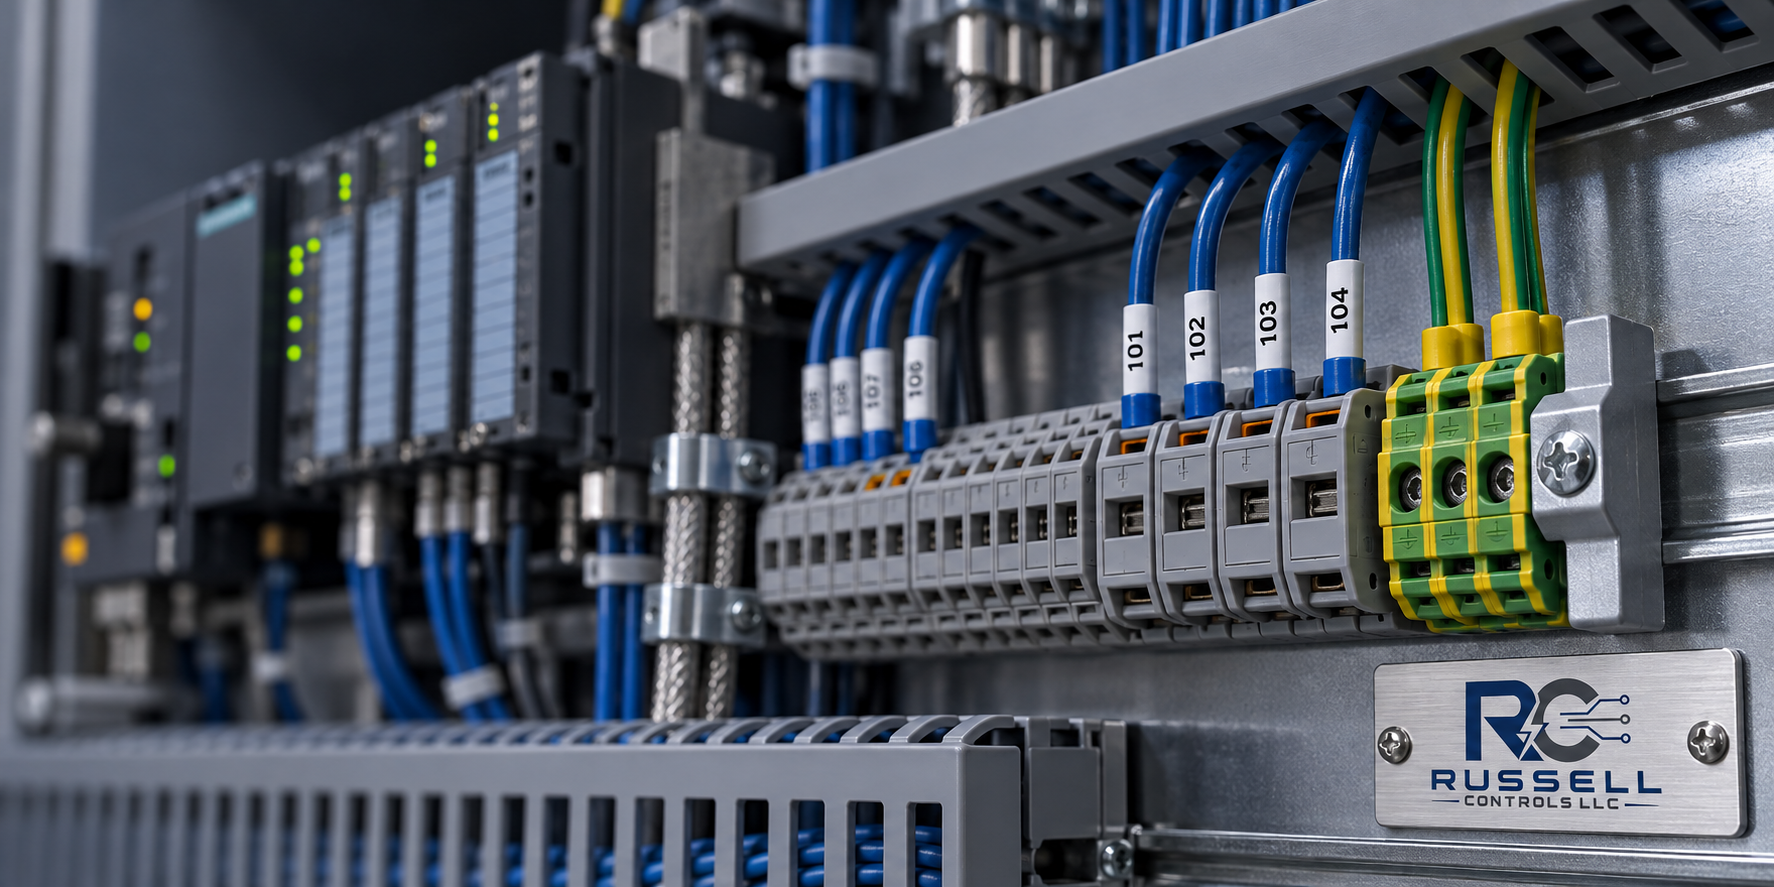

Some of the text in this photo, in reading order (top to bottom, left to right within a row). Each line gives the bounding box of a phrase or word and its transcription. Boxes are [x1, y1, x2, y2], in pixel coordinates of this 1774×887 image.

[1260, 301, 1277, 346] 103
[1331, 287, 1348, 334] 104
[1127, 330, 1144, 371] 101
[1189, 316, 1205, 360] 102
[1465, 678, 1601, 762] RC
[1431, 769, 1662, 794] RUSSELL
[1464, 795, 1620, 810] CONTROLS LLC
